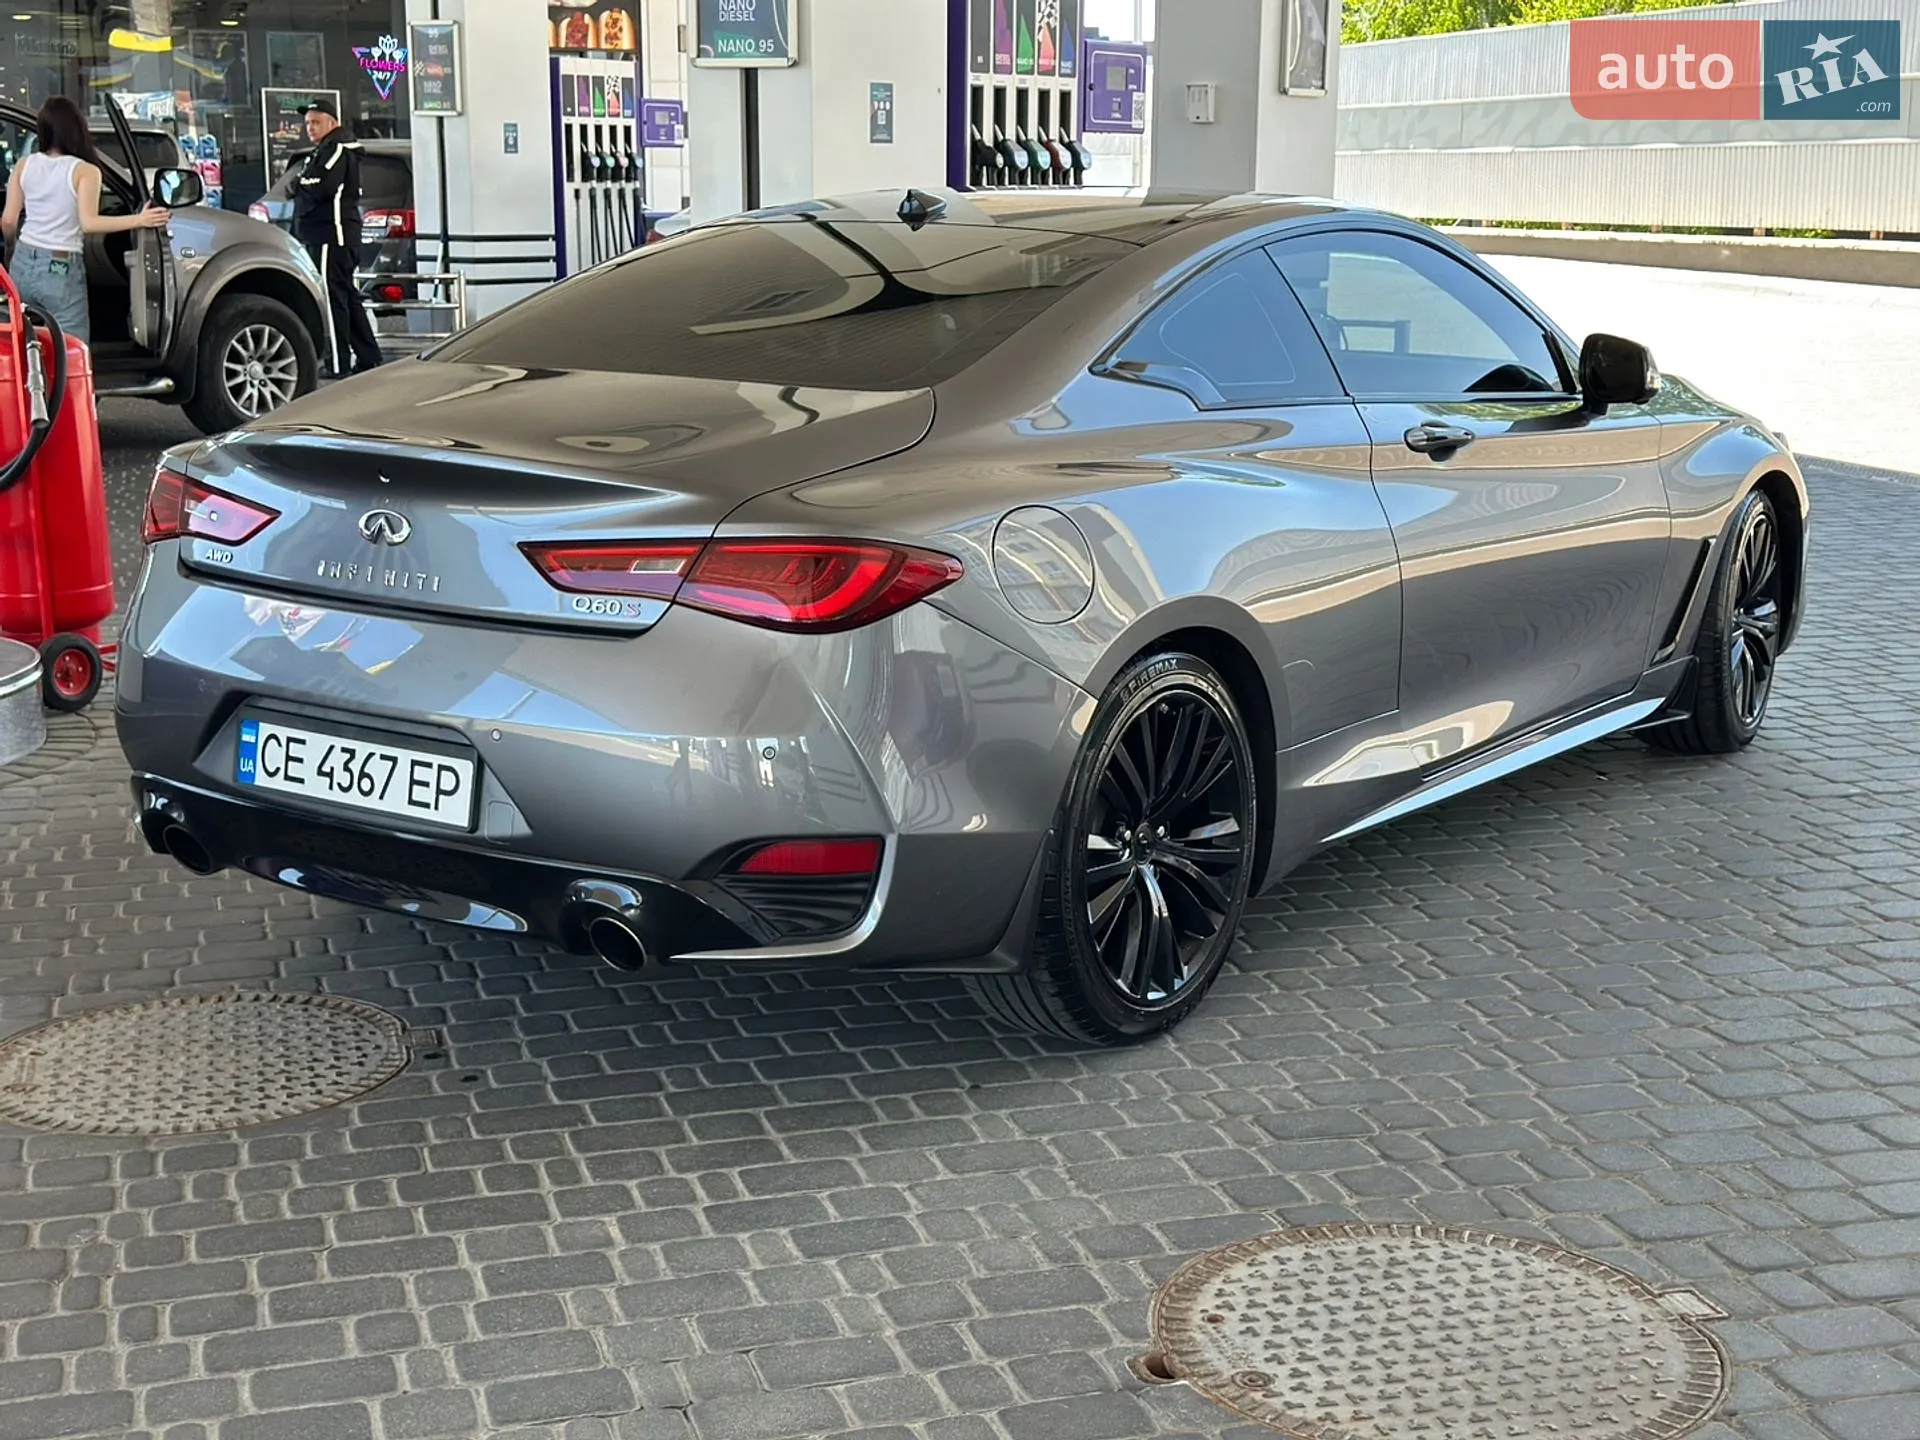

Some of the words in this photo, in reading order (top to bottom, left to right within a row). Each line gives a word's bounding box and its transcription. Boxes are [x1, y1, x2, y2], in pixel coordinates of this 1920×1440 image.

[719, 0, 756, 11] NANO
[719, 10, 756, 22] DIESEL
[717, 38, 755, 53] NANO
[758, 39, 775, 53] 95
[360, 58, 406, 72] FLOWERS
[373, 70, 391, 80] 24/7
[205, 549, 233, 563] AWD
[317, 560, 441, 593] INFINITI
[572, 595, 622, 615] Q60
[239, 757, 255, 774] UA
[261, 733, 306, 784] CE
[316, 744, 399, 800] 4367
[407, 758, 461, 811] EP
